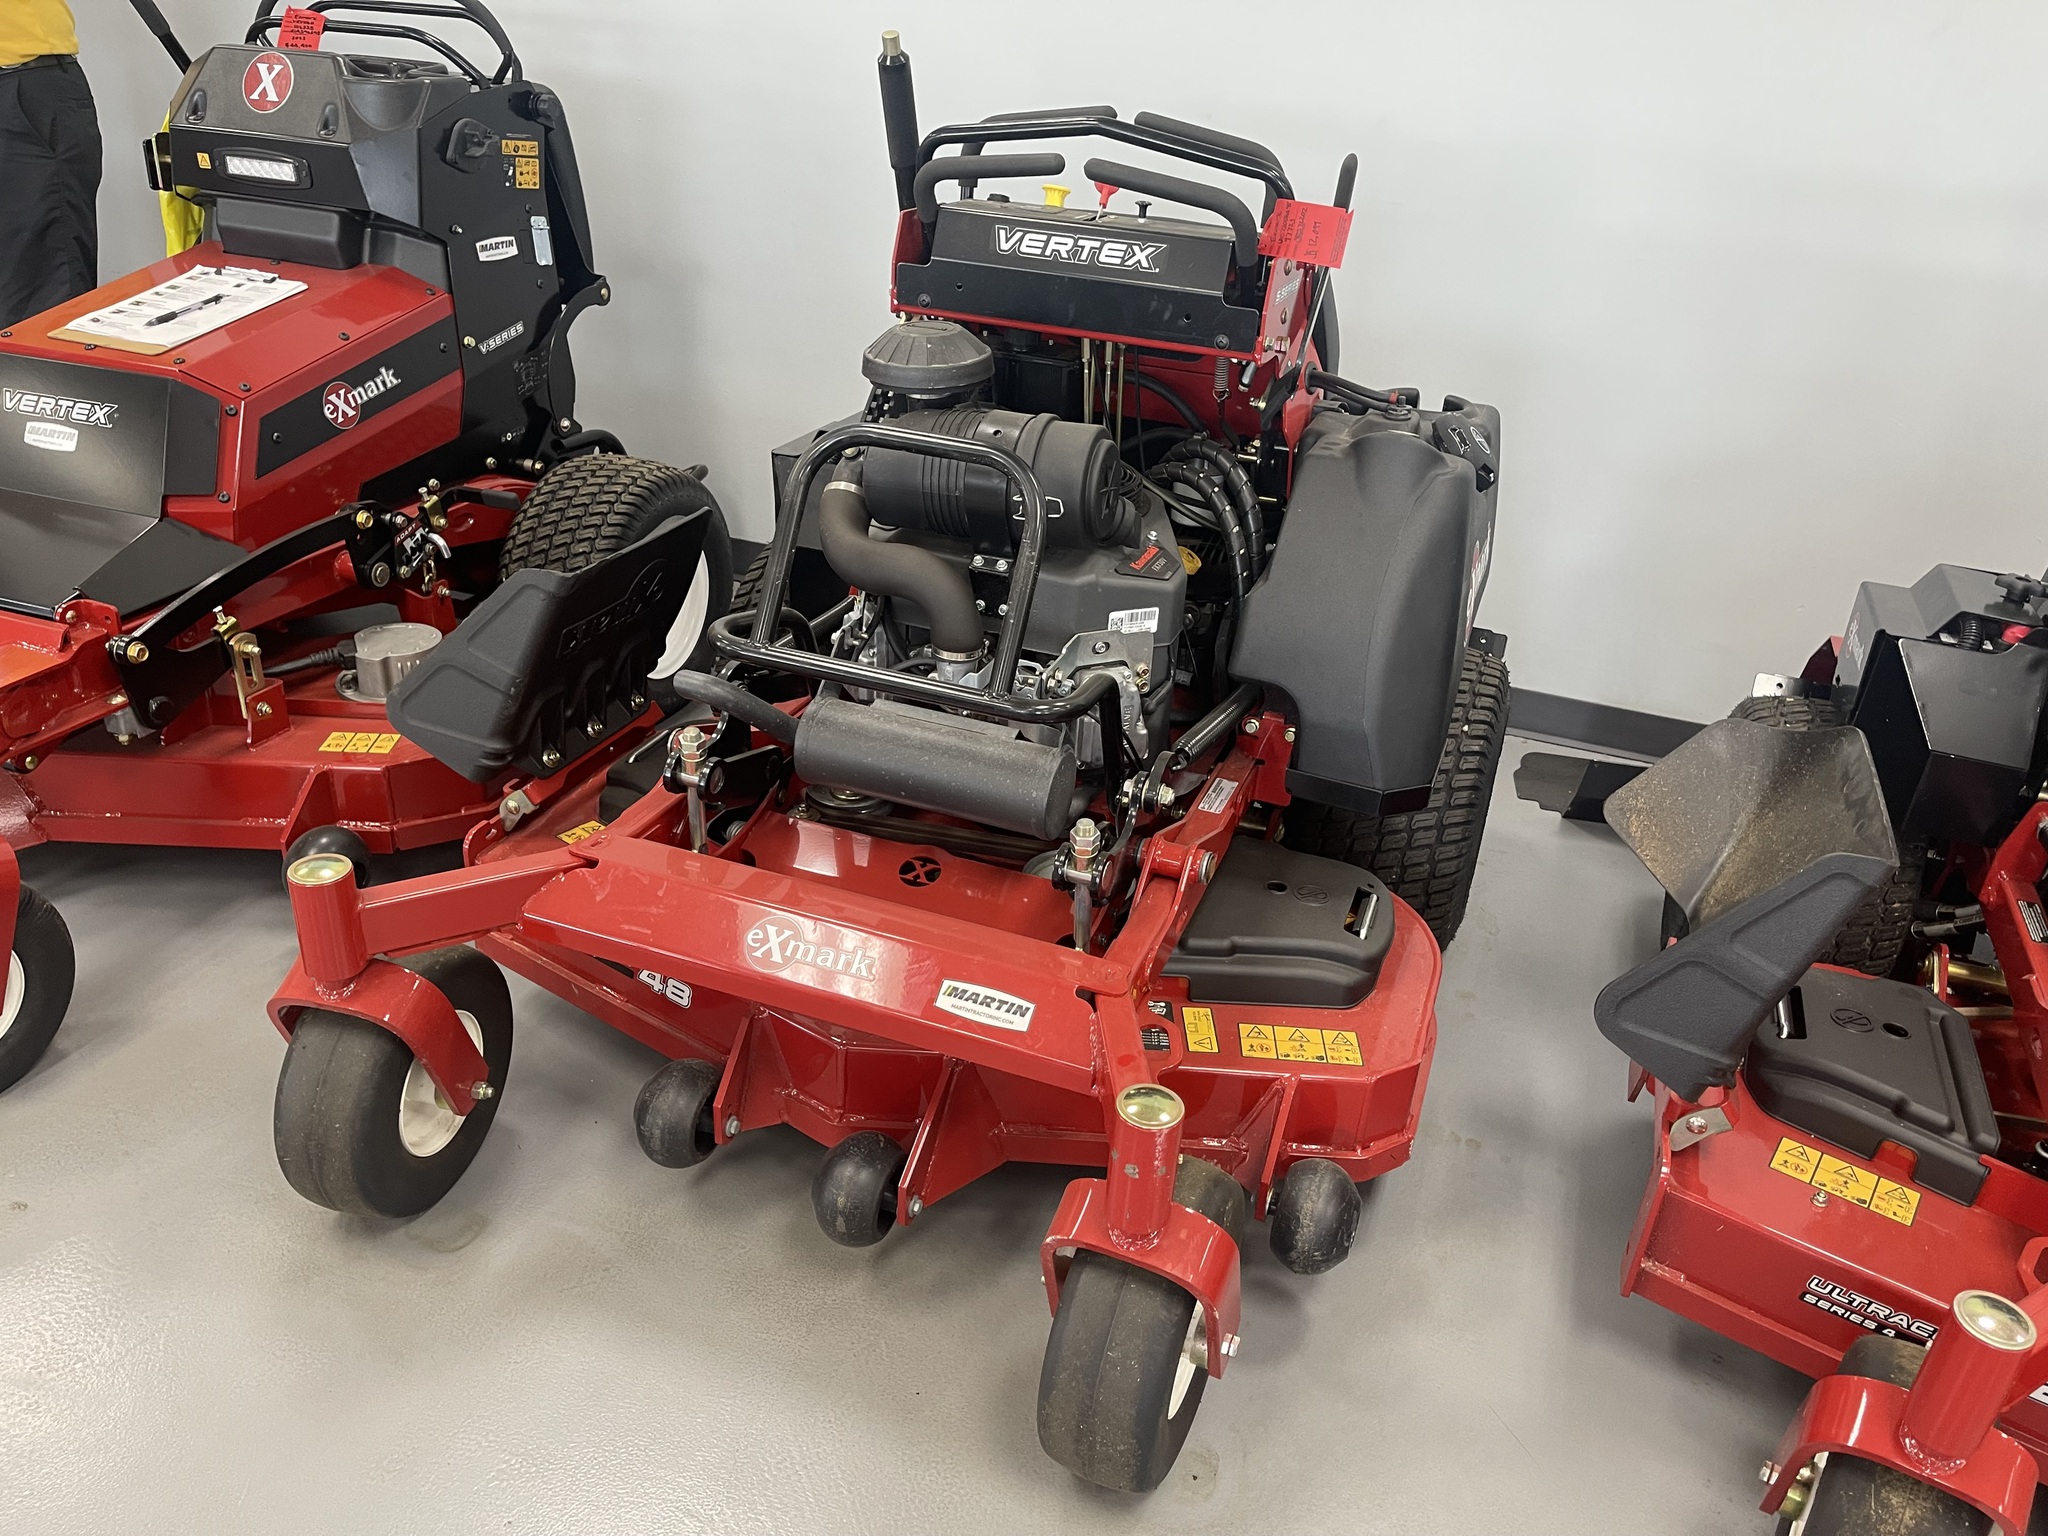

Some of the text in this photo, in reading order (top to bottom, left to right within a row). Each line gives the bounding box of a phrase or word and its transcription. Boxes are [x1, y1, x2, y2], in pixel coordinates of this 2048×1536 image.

[249, 62, 284, 102] X
[479, 239, 514, 253] MARTIN
[995, 224, 1168, 273] VERTEX
[3, 387, 119, 429] VERTEX
[323, 365, 401, 424] eXmark
[27, 425, 76, 442] MARTIN
[746, 922, 876, 979] eXmark
[637, 968, 693, 1009] 48
[943, 985, 1031, 1018] MARTIN
[1803, 1293, 1897, 1338] SERIES 4
[1806, 1274, 1939, 1340] ULTRAC
